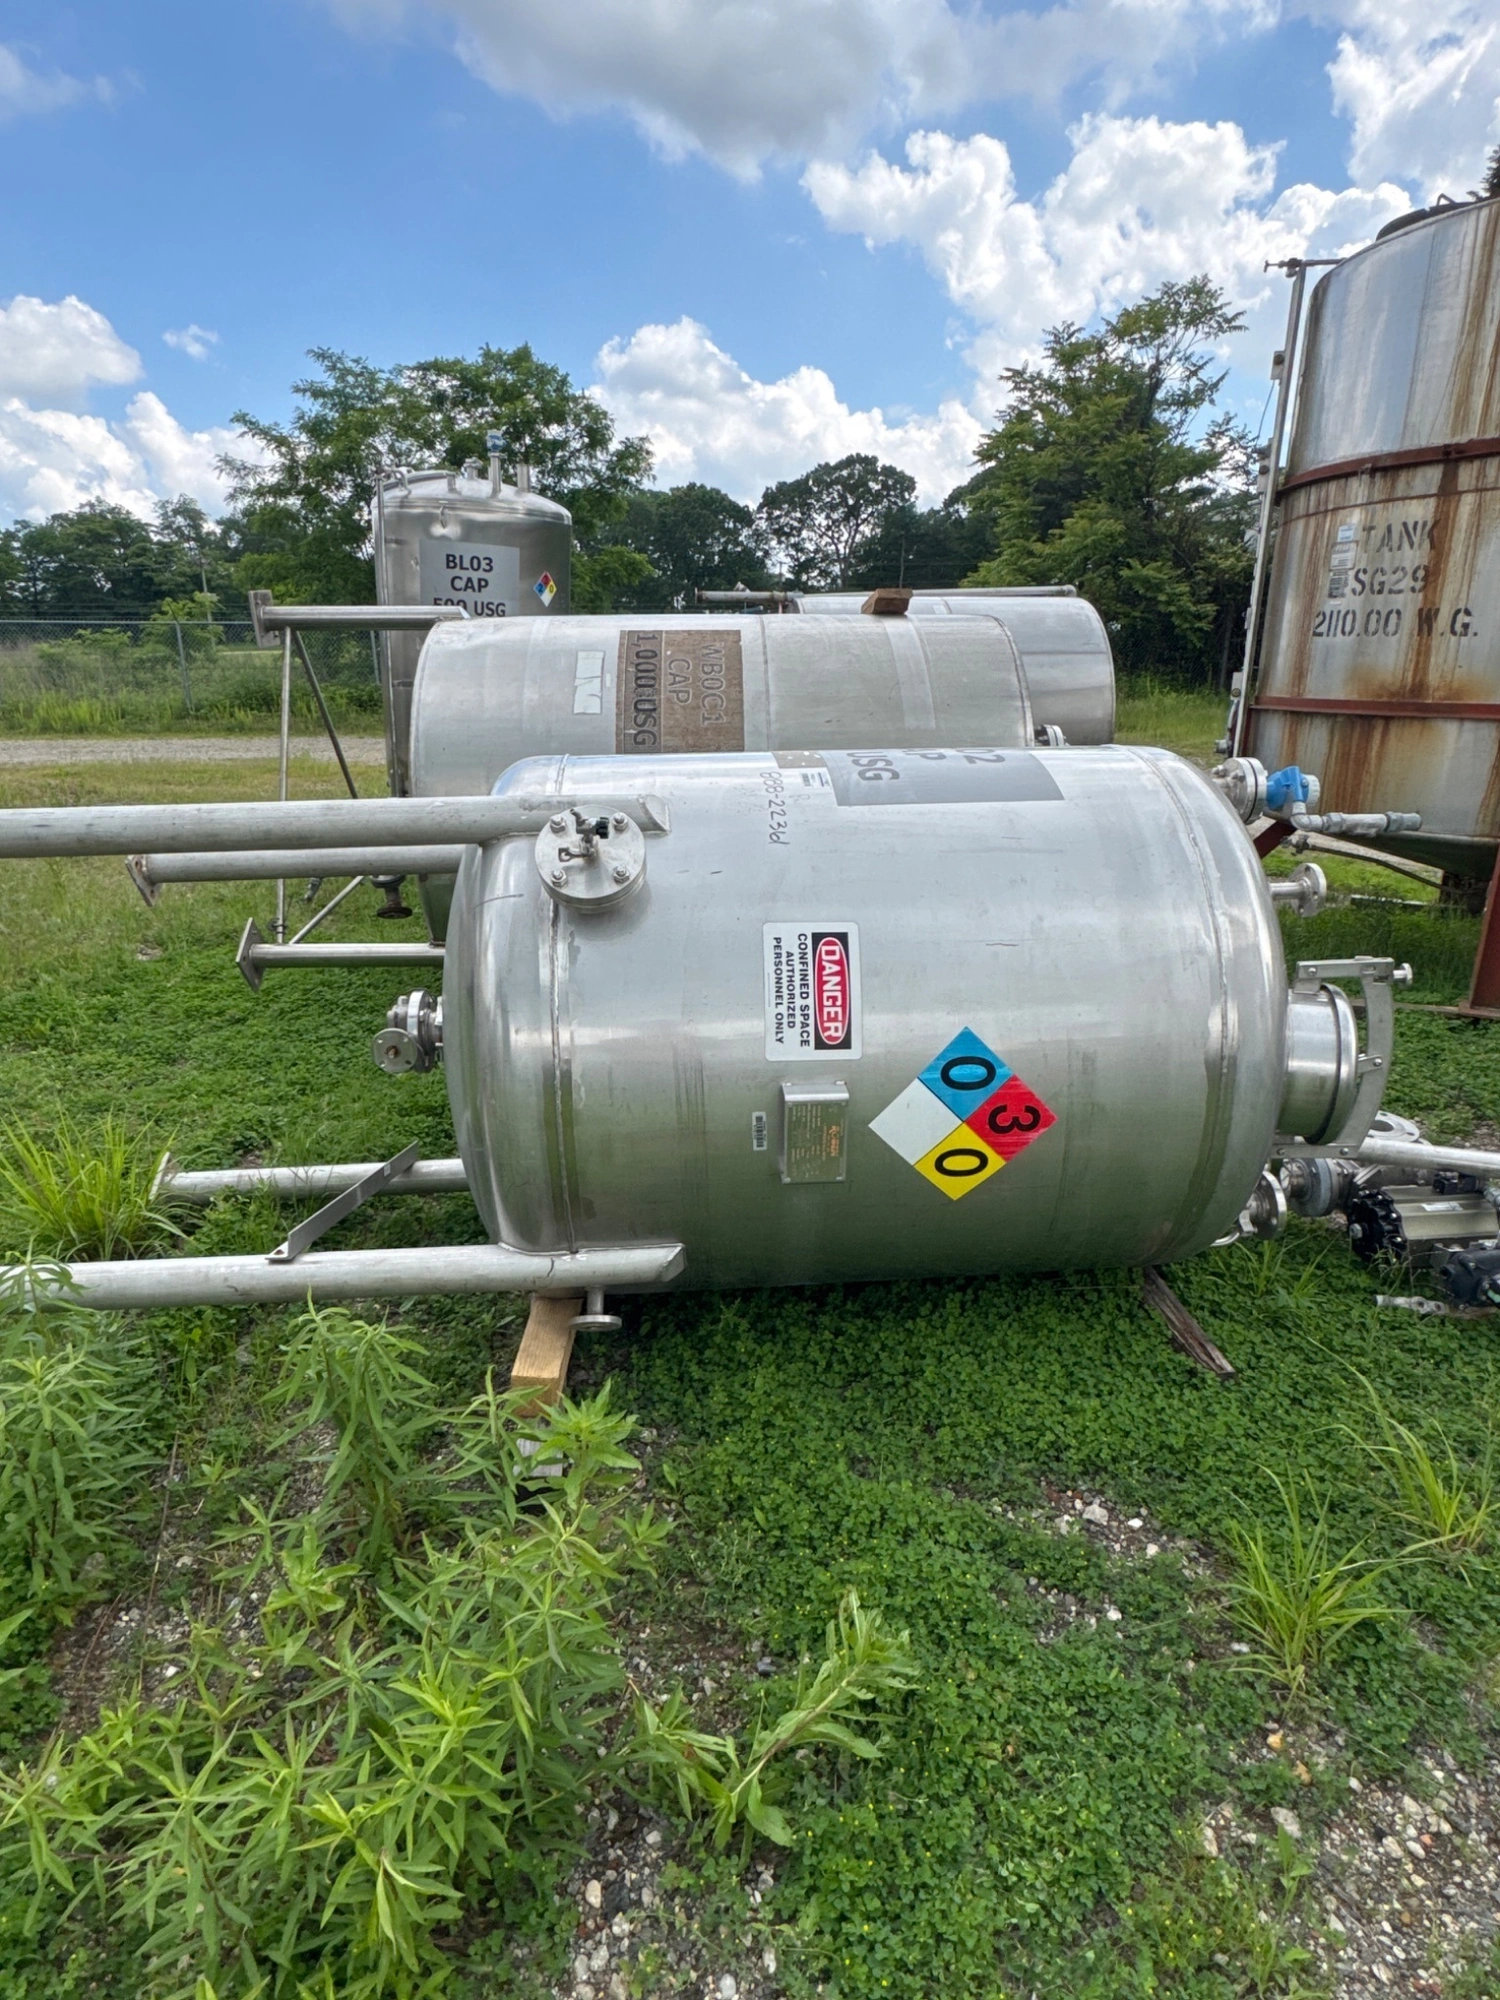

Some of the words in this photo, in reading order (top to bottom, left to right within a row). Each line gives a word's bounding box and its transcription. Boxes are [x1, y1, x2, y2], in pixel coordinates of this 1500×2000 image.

[1362, 520, 1440, 553] TANK
[446, 554, 494, 573] BL03
[450, 575, 489, 593] CAP
[1351, 564, 1432, 597] SG29
[474, 600, 506, 617] USG
[668, 658, 692, 704] CAP
[633, 698, 657, 746] USG
[846, 751, 900, 781] USG
[773, 937, 784, 1009] PERSONNEL
[798, 933, 810, 1000] CONFINED
[785, 951, 796, 1029] AUTHORIZED
[821, 945, 842, 1037] DANGER
[775, 1012, 784, 1044] ONLY
[800, 1004, 810, 1047] SPACE
[940, 1056, 997, 1091] 0
[988, 1104, 1041, 1134] 3
[934, 1148, 989, 1177] 0
